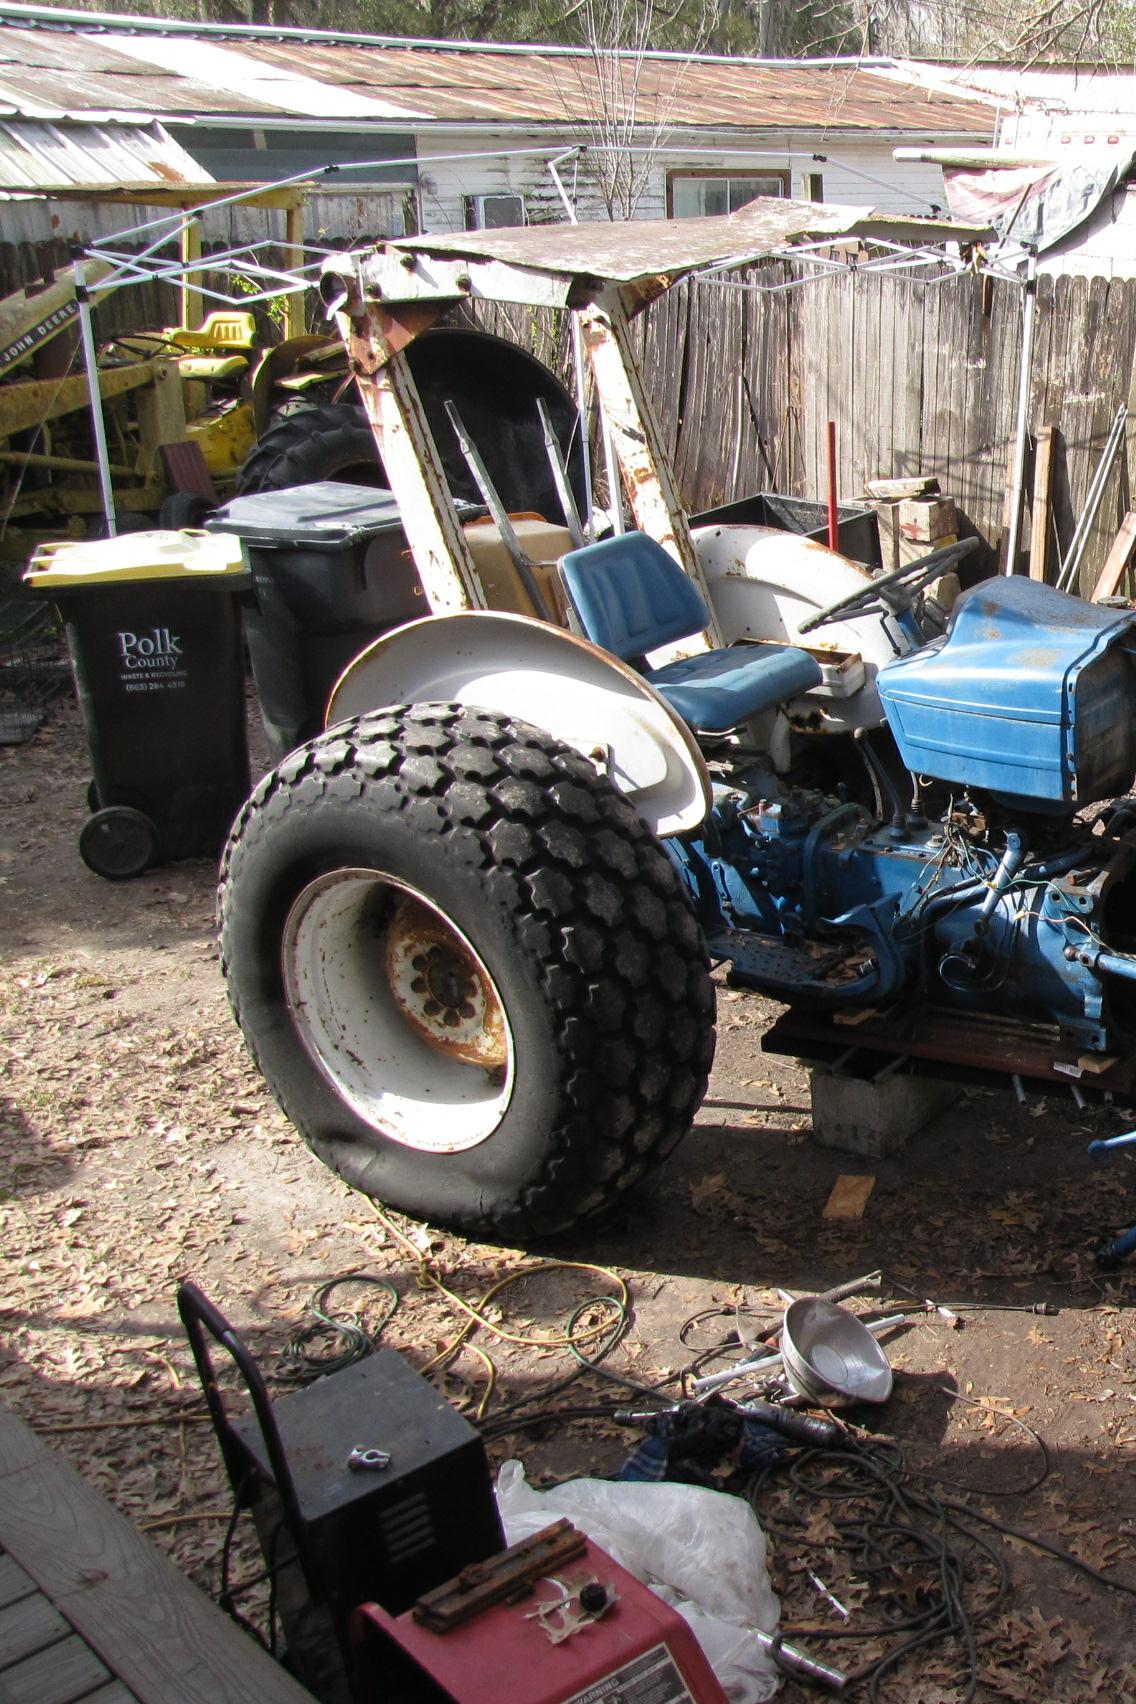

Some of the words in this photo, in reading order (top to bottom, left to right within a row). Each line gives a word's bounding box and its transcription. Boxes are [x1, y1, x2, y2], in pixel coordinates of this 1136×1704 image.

[3, 335, 35, 362] JOHN
[37, 304, 77, 336] DEERE
[117, 628, 183, 656] Polk
[126, 655, 178, 670] County
[120, 671, 144, 680] WASTE
